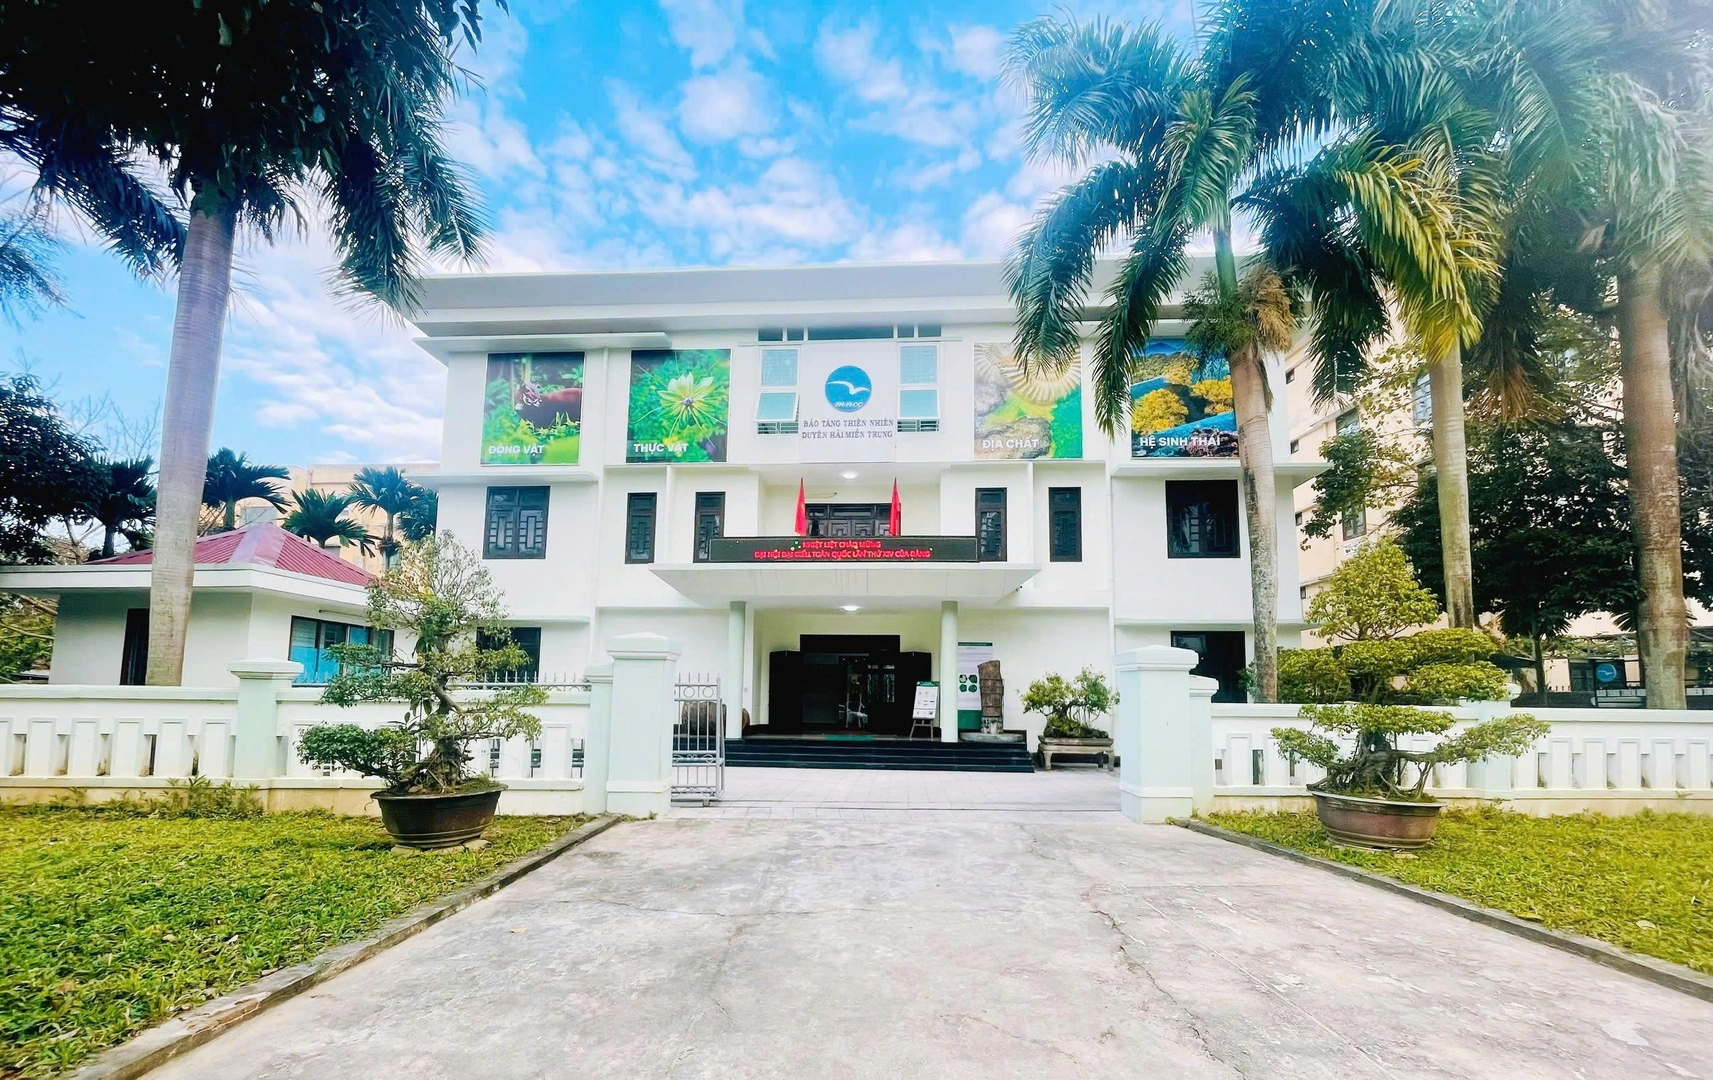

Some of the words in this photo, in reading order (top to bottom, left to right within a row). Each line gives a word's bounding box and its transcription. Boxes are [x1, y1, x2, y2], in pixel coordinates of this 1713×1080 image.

[803, 418, 819, 428] BẢO
[821, 419, 841, 428] TÀNG
[843, 419, 867, 427] THIÊN
[869, 418, 894, 427] NHIÊN
[802, 430, 828, 439] DUYÊN
[830, 429, 844, 439] HẢI
[982, 440, 1003, 451] ĐỊA
[1005, 434, 1039, 448] CHẤT
[1140, 435, 1156, 449] HỆ
[1158, 437, 1188, 446] SINH
[1190, 433, 1220, 446] THÁI
[488, 443, 521, 457] ĐỘNG
[523, 443, 545, 456] VẬT
[633, 442, 665, 455] THỰC
